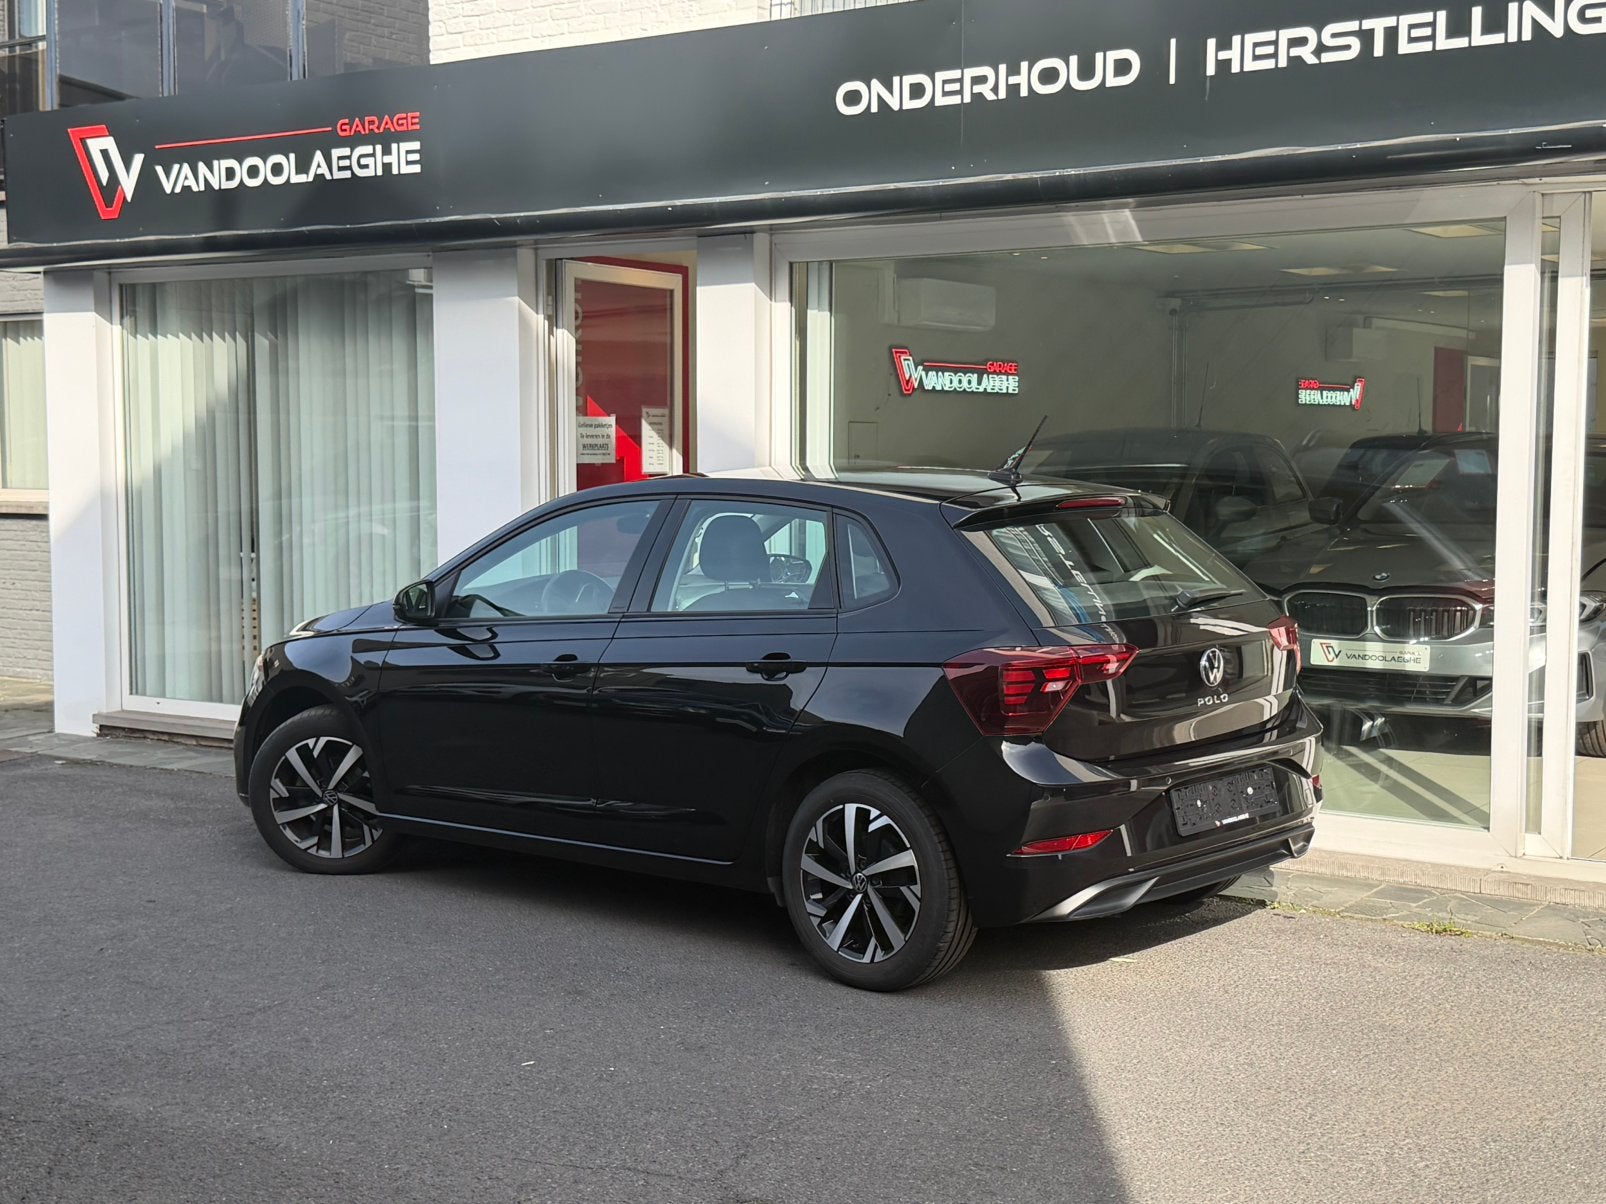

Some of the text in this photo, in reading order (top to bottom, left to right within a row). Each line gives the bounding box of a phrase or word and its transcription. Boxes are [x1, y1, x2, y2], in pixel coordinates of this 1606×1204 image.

[835, 0, 1606, 116] ONDERHOUD HERSTELLING
[337, 112, 421, 137] GARAGE
[154, 140, 422, 195] VANDOOLAEGHE
[987, 361, 1019, 374] GARAGE
[920, 370, 1019, 393] VANDOOLAEGHE
[1345, 652, 1422, 664] VANDOOLAEGHE
[1197, 693, 1229, 707] POLO
